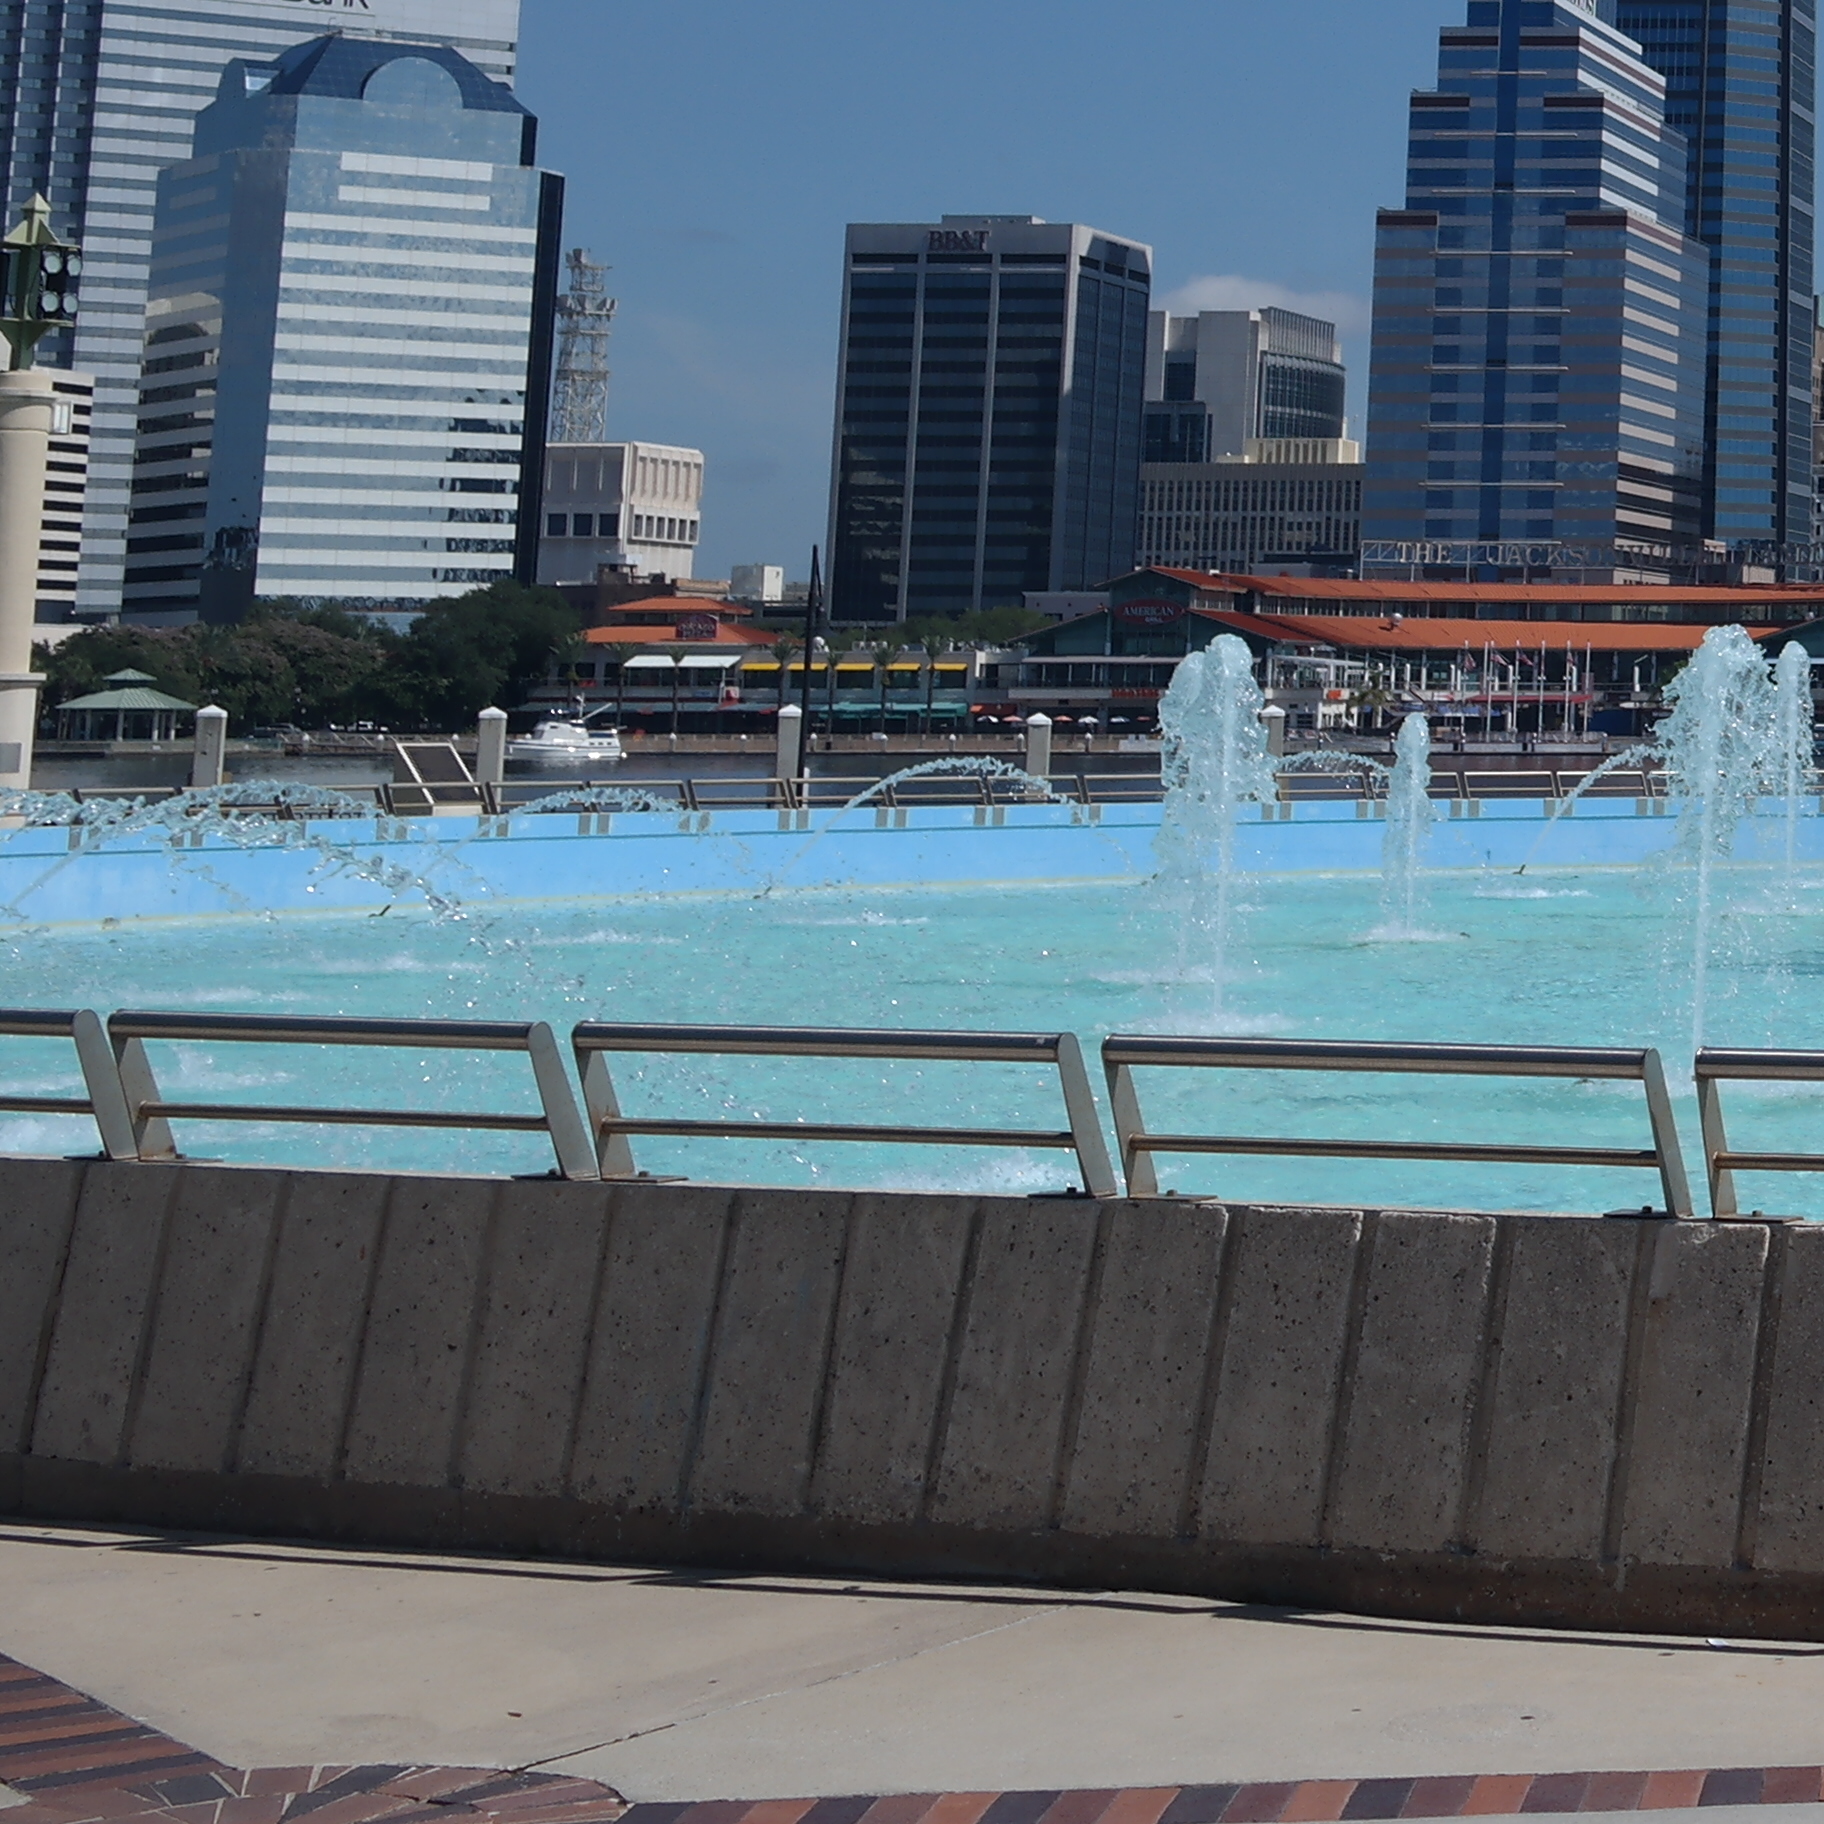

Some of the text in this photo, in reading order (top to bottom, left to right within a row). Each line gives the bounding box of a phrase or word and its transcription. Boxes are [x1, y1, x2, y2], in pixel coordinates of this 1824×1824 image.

[928, 228, 991, 252] BB&T
[1397, 542, 1451, 564] THE
[1122, 606, 1175, 616] AMERICAN
